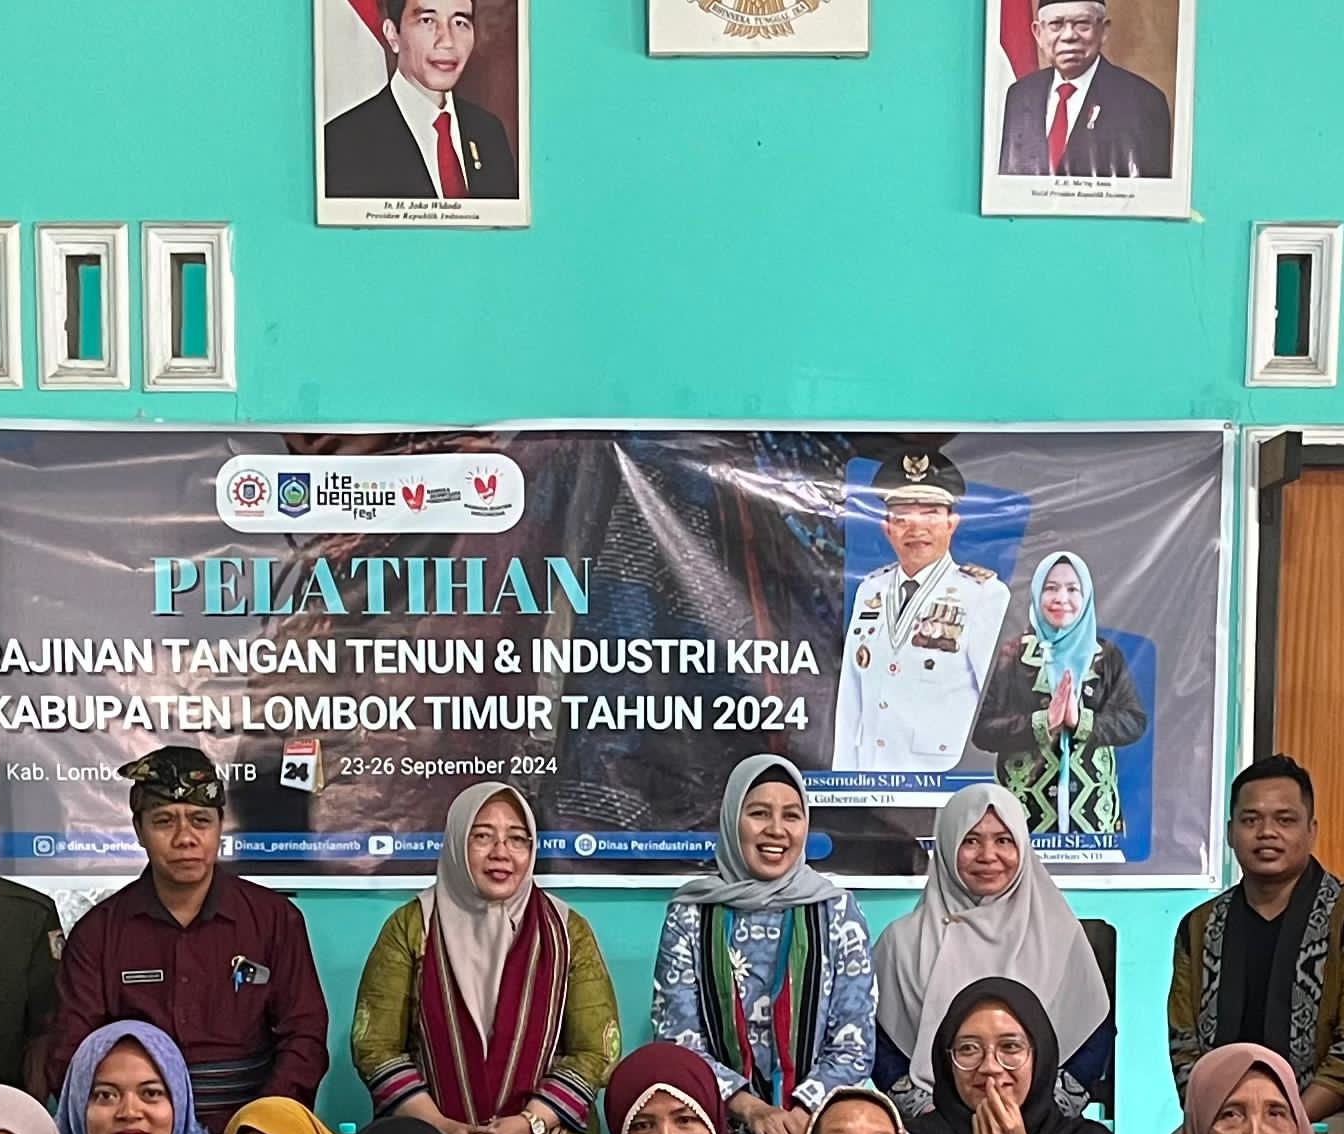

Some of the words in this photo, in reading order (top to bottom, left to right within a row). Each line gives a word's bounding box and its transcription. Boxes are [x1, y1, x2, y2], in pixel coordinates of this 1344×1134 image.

[408, 201, 429, 210] Joko
[431, 201, 462, 210] Widodo
[402, 212, 438, 221] Republik
[324, 472, 352, 490] ite
[316, 485, 396, 511] begawe
[149, 556, 590, 617] PELATIHAN
[162, 638, 336, 674] TANGAN
[346, 638, 484, 674] TENUN
[494, 638, 521, 674] &
[532, 638, 715, 674] INDUSTRI
[728, 638, 820, 675] KRIA
[242, 695, 416, 730] LOMBOK
[423, 695, 553, 730] TIMUR
[562, 695, 703, 730] TAHUN
[712, 695, 809, 731] 2024
[6, 762, 49, 781] Kab.
[56, 762, 121, 781] Lombo
[216, 763, 257, 782] NTB
[284, 762, 310, 782] 24
[340, 757, 395, 775] 23-26
[400, 755, 506, 779] September
[510, 756, 558, 775] 2024
[803, 773, 875, 788] assanudin
[394, 839, 430, 851] Dinas
[598, 839, 629, 851] Dinas
[630, 839, 703, 852] Perindustrian
[1031, 834, 1062, 849] anti
